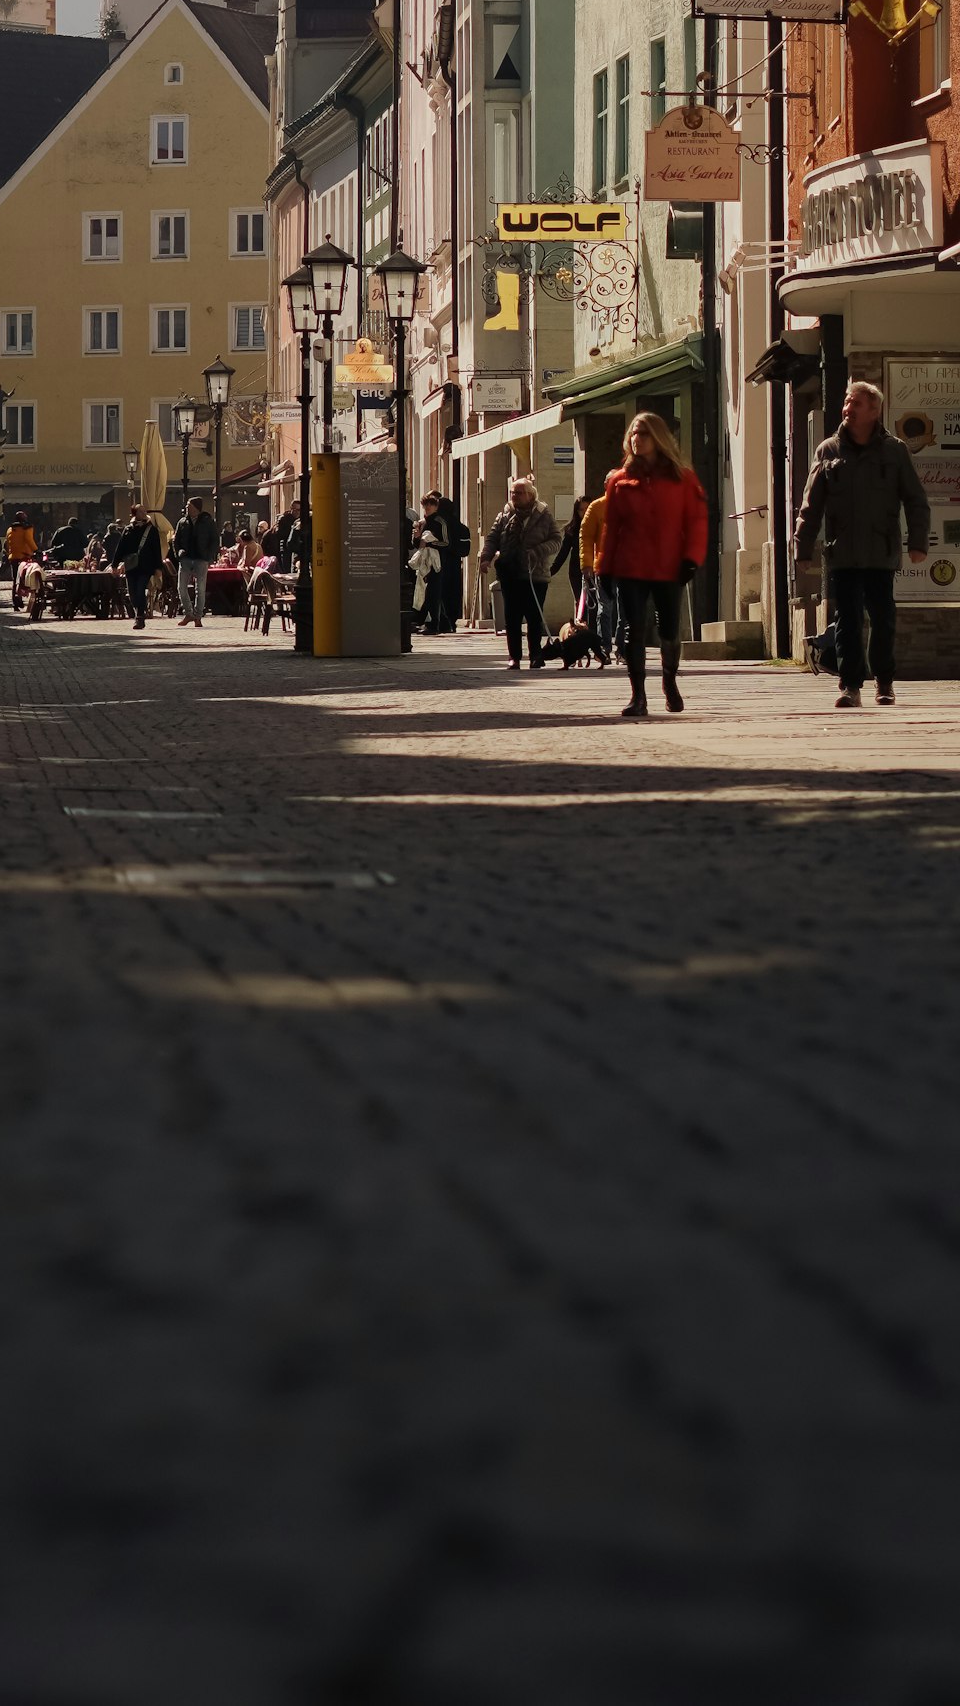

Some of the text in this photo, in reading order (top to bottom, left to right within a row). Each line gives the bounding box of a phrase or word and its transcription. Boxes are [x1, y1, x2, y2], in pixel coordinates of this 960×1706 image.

[667, 147, 721, 156] RESTAURANT
[651, 164, 734, 182] Asia Garten
[502, 212, 621, 233] WOLF
[901, 367, 929, 378] CITY
[896, 569, 927, 577] SUSHI
